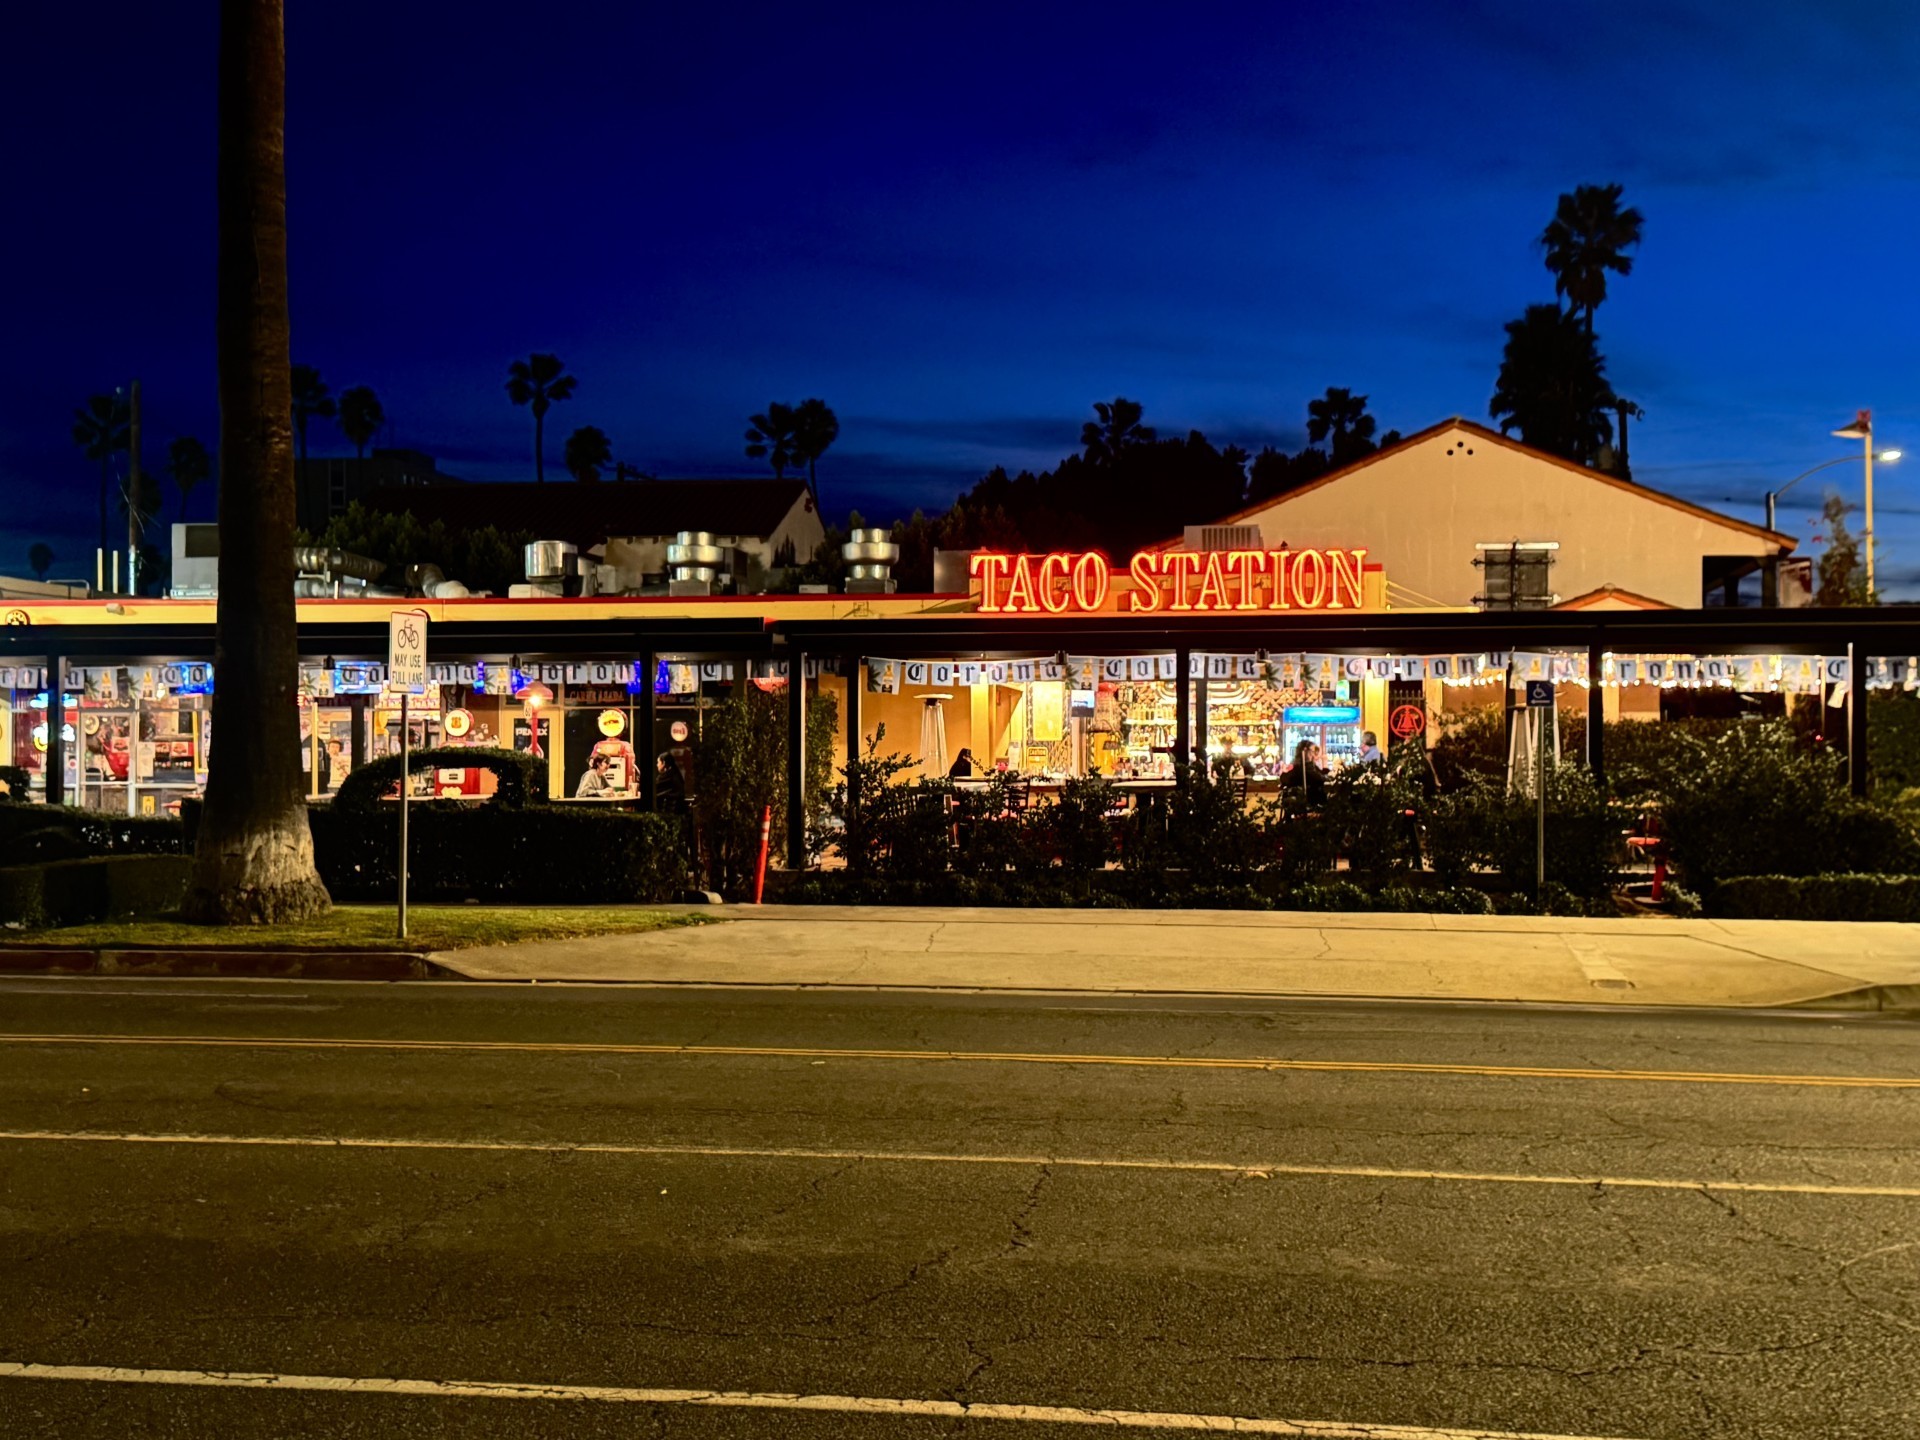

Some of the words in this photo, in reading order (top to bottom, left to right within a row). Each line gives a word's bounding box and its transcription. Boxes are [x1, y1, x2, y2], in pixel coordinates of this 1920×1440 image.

[970, 551, 1108, 613] TACO
[1130, 548, 1367, 613] STATION
[394, 653, 407, 667] MAY
[410, 654, 421, 668] USE
[1346, 652, 1503, 676] Corona
[392, 670, 406, 685] FULL
[408, 672, 422, 685] LANE
[907, 662, 1058, 682] Corona
